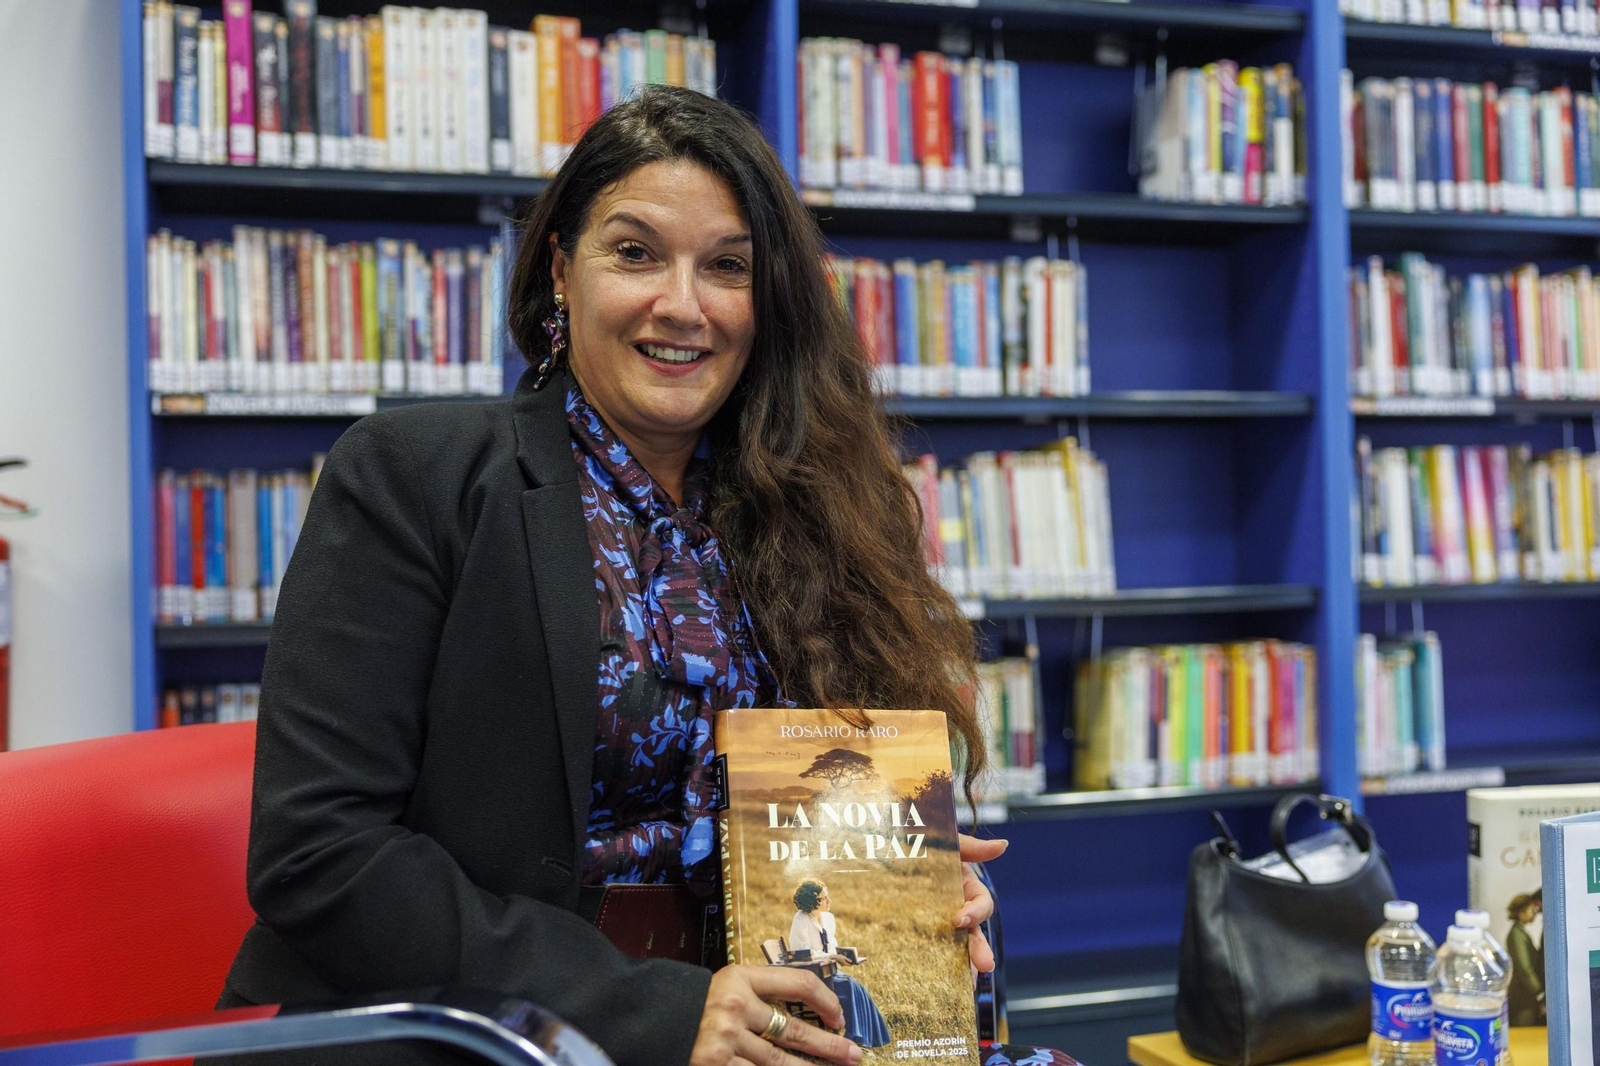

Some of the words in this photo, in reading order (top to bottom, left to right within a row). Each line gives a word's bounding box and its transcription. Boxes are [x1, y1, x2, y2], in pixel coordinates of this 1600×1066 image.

[781, 725, 851, 739] ROSARIO
[855, 725, 898, 739] RARO
[767, 803, 812, 829] LA
[818, 802, 926, 828] NOVIA
[768, 840, 810, 861] DE
[819, 840, 857, 860] LA
[864, 833, 928, 860] PAZ
[726, 914, 735, 966] OVIA
[897, 1038, 931, 1048] PREMIO
[933, 1035, 966, 1046] AZORÍN
[896, 1050, 909, 1059] DE
[911, 1048, 947, 1058] NOVELA
[948, 1047, 968, 1056] 2025
